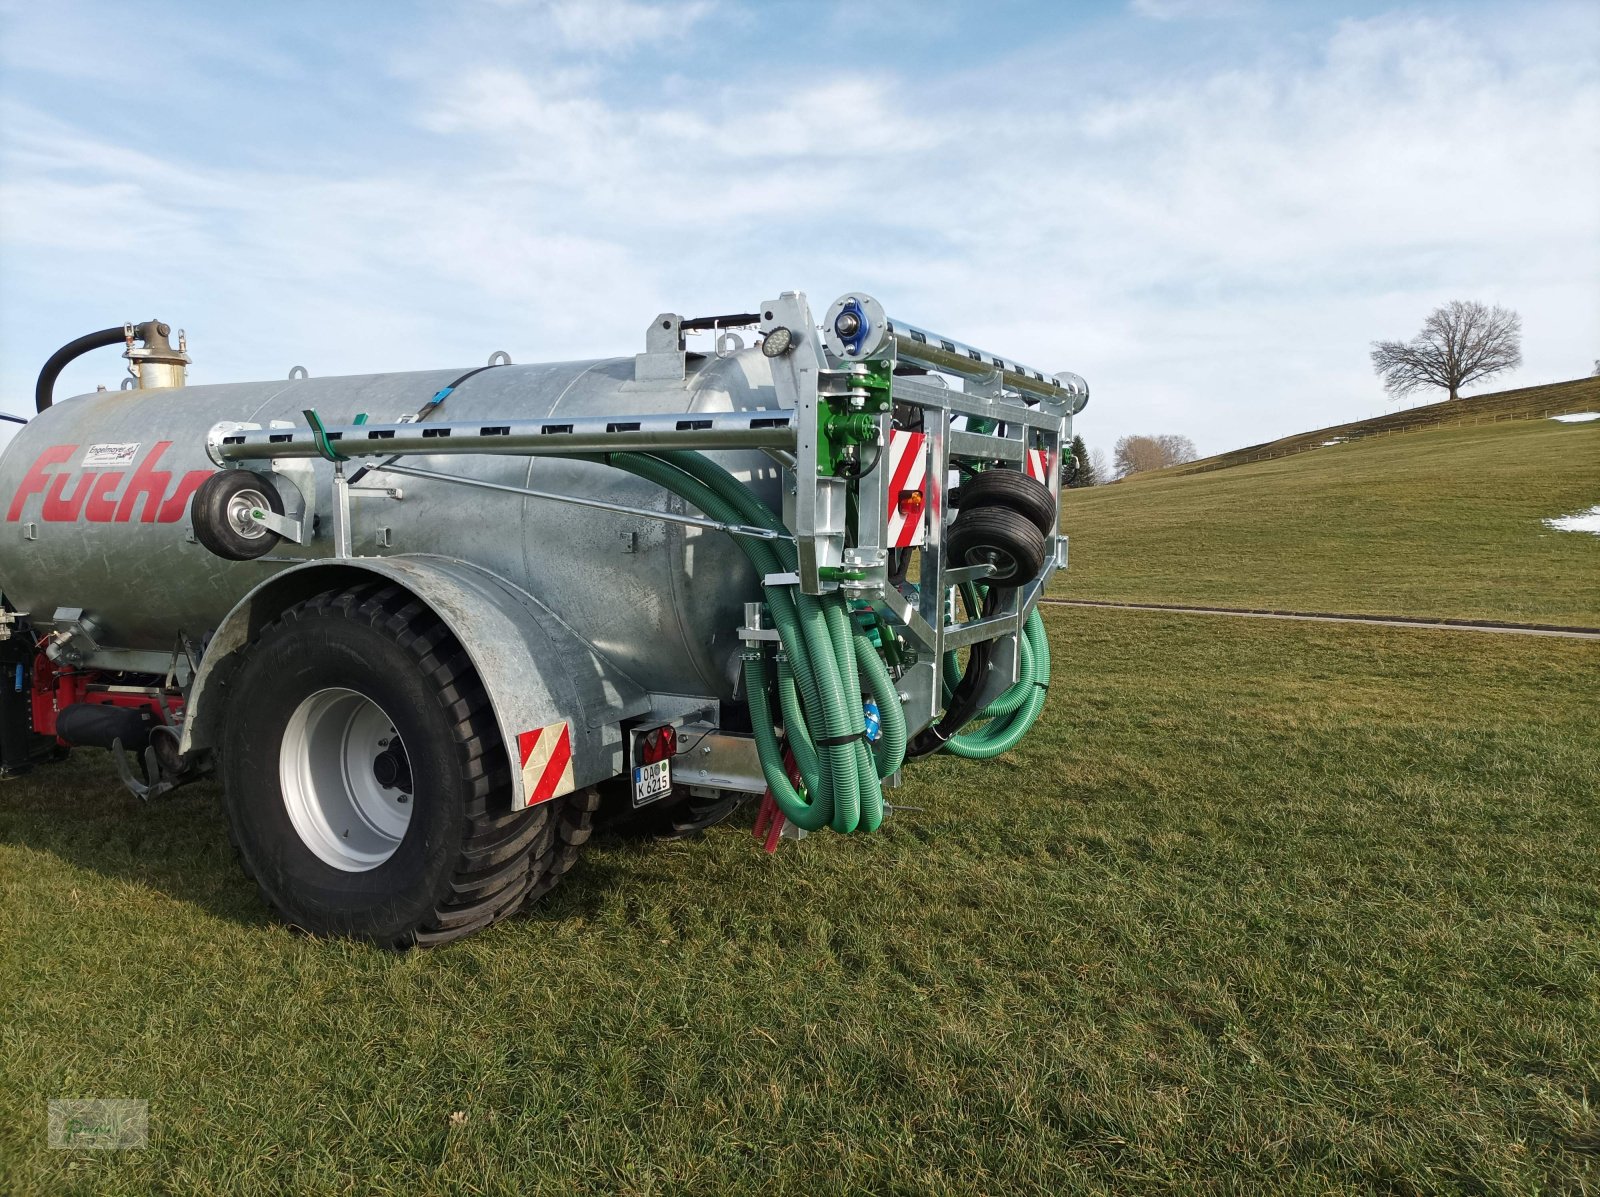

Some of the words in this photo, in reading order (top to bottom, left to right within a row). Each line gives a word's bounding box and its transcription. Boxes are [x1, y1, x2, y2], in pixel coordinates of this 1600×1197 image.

[6, 441, 215, 522] Fuchs
[643, 768, 655, 781] OA
[638, 783, 644, 797] K
[646, 775, 667, 794] 6215
